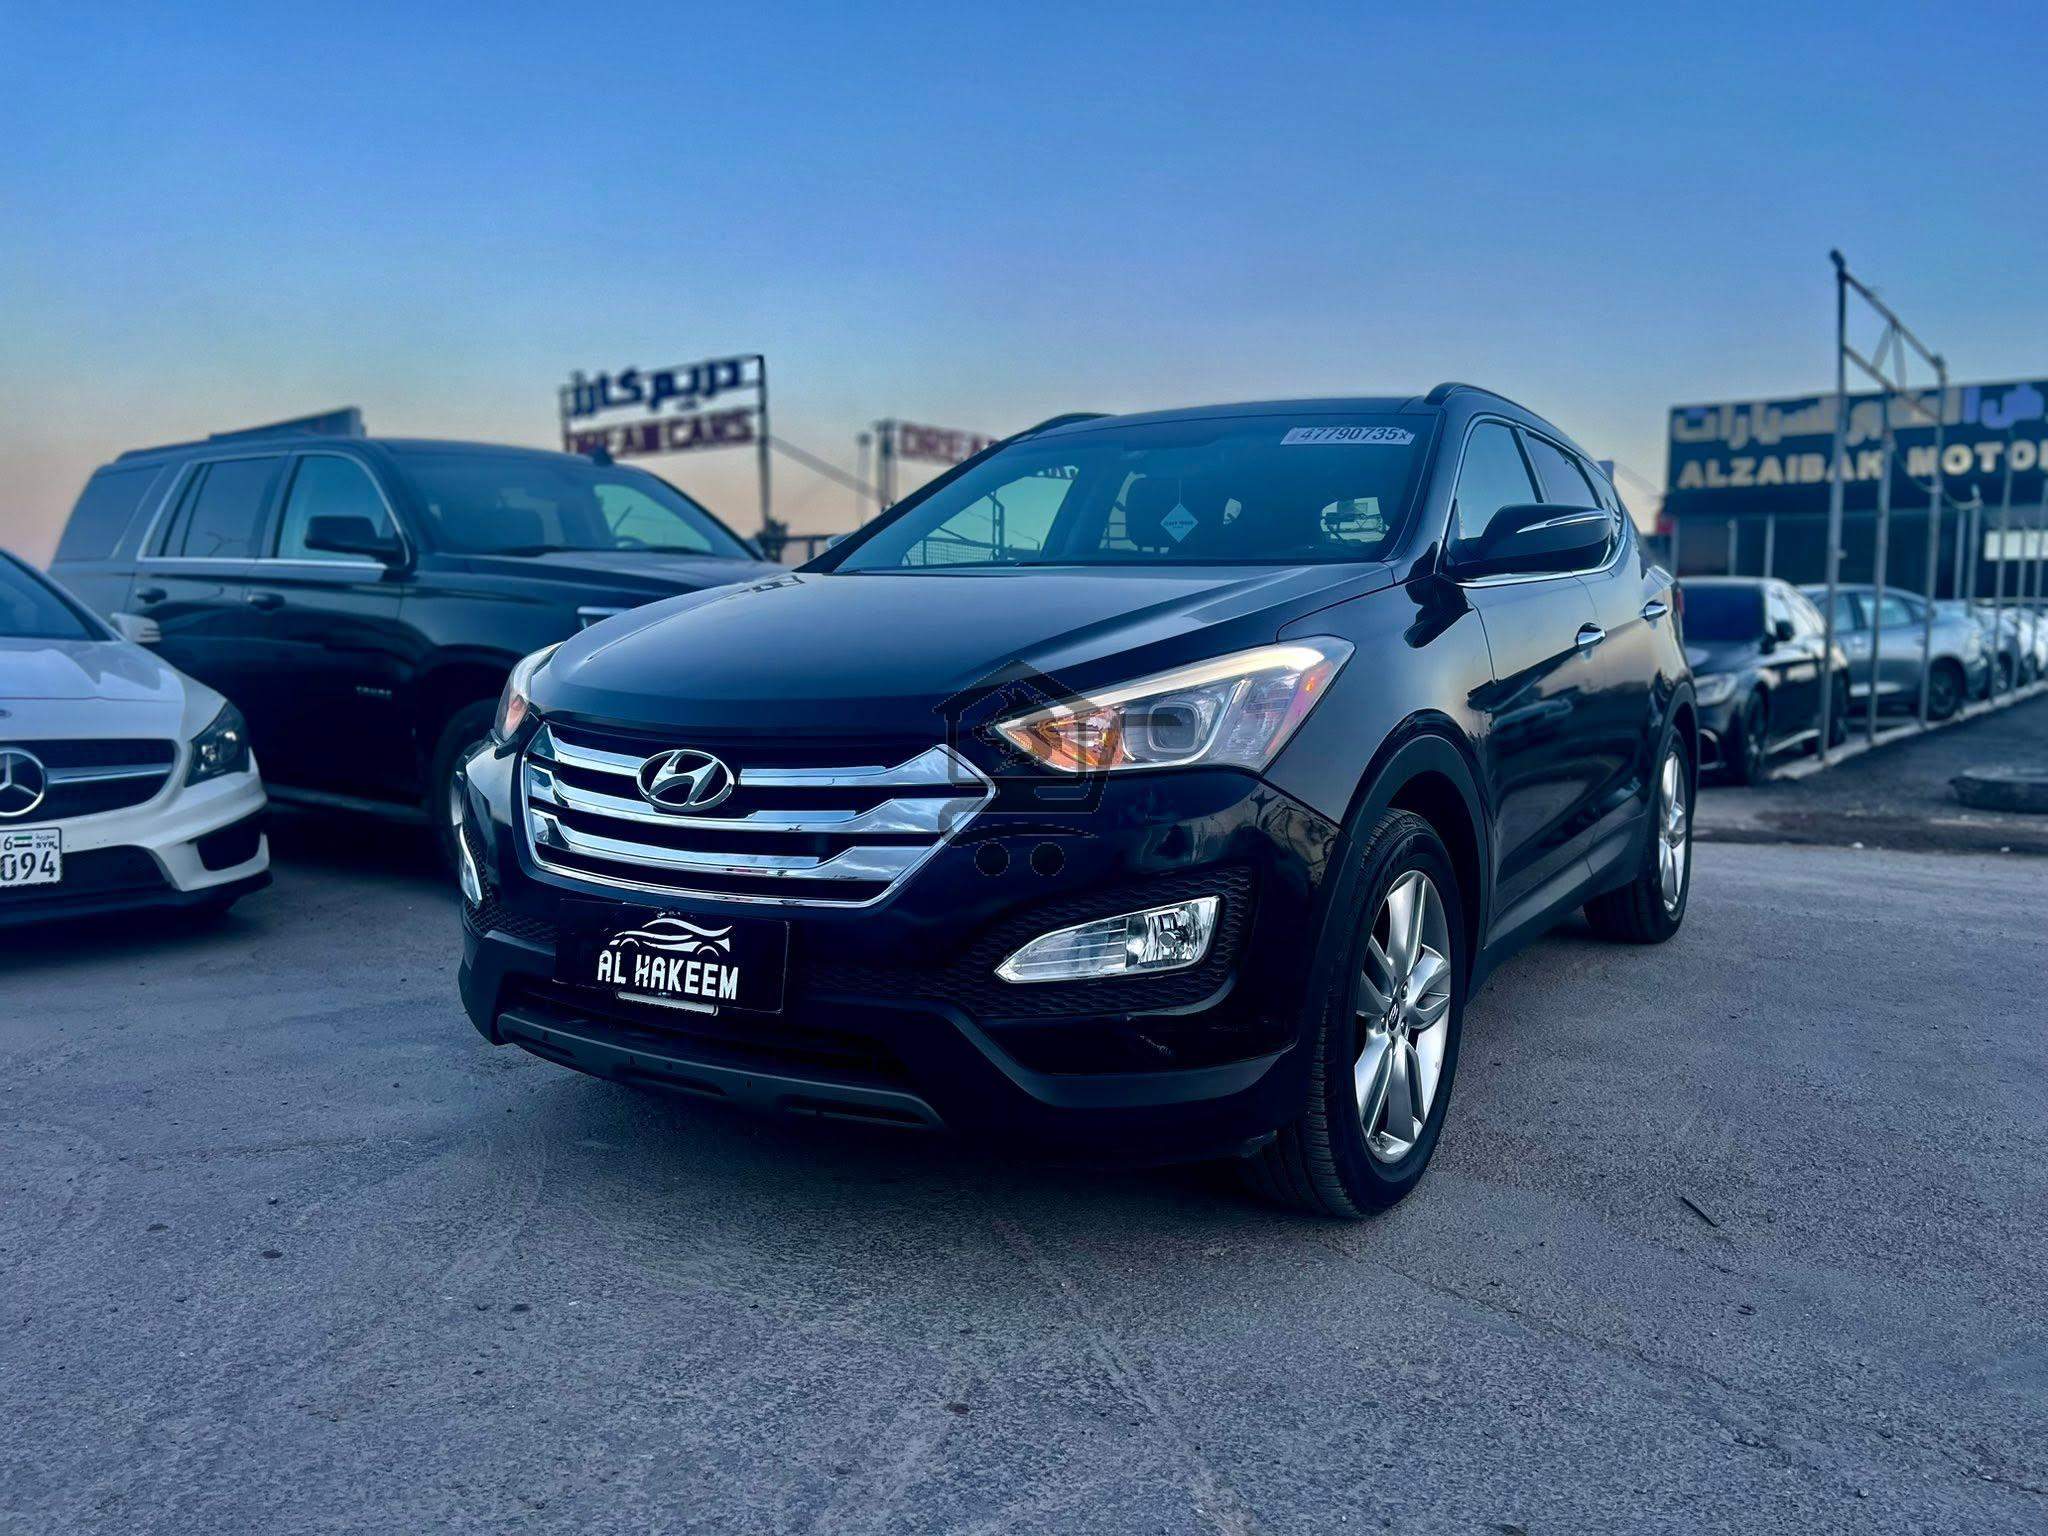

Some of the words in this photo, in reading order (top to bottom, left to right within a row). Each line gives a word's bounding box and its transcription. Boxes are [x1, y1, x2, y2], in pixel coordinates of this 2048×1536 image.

[571, 366, 644, 416] كارز
[649, 361, 741, 410] دريم
[668, 408, 753, 448] CARS
[1677, 450, 1886, 488] ALZAIBAK
[597, 950, 626, 984] AL
[635, 954, 739, 1000] HAKEEM
